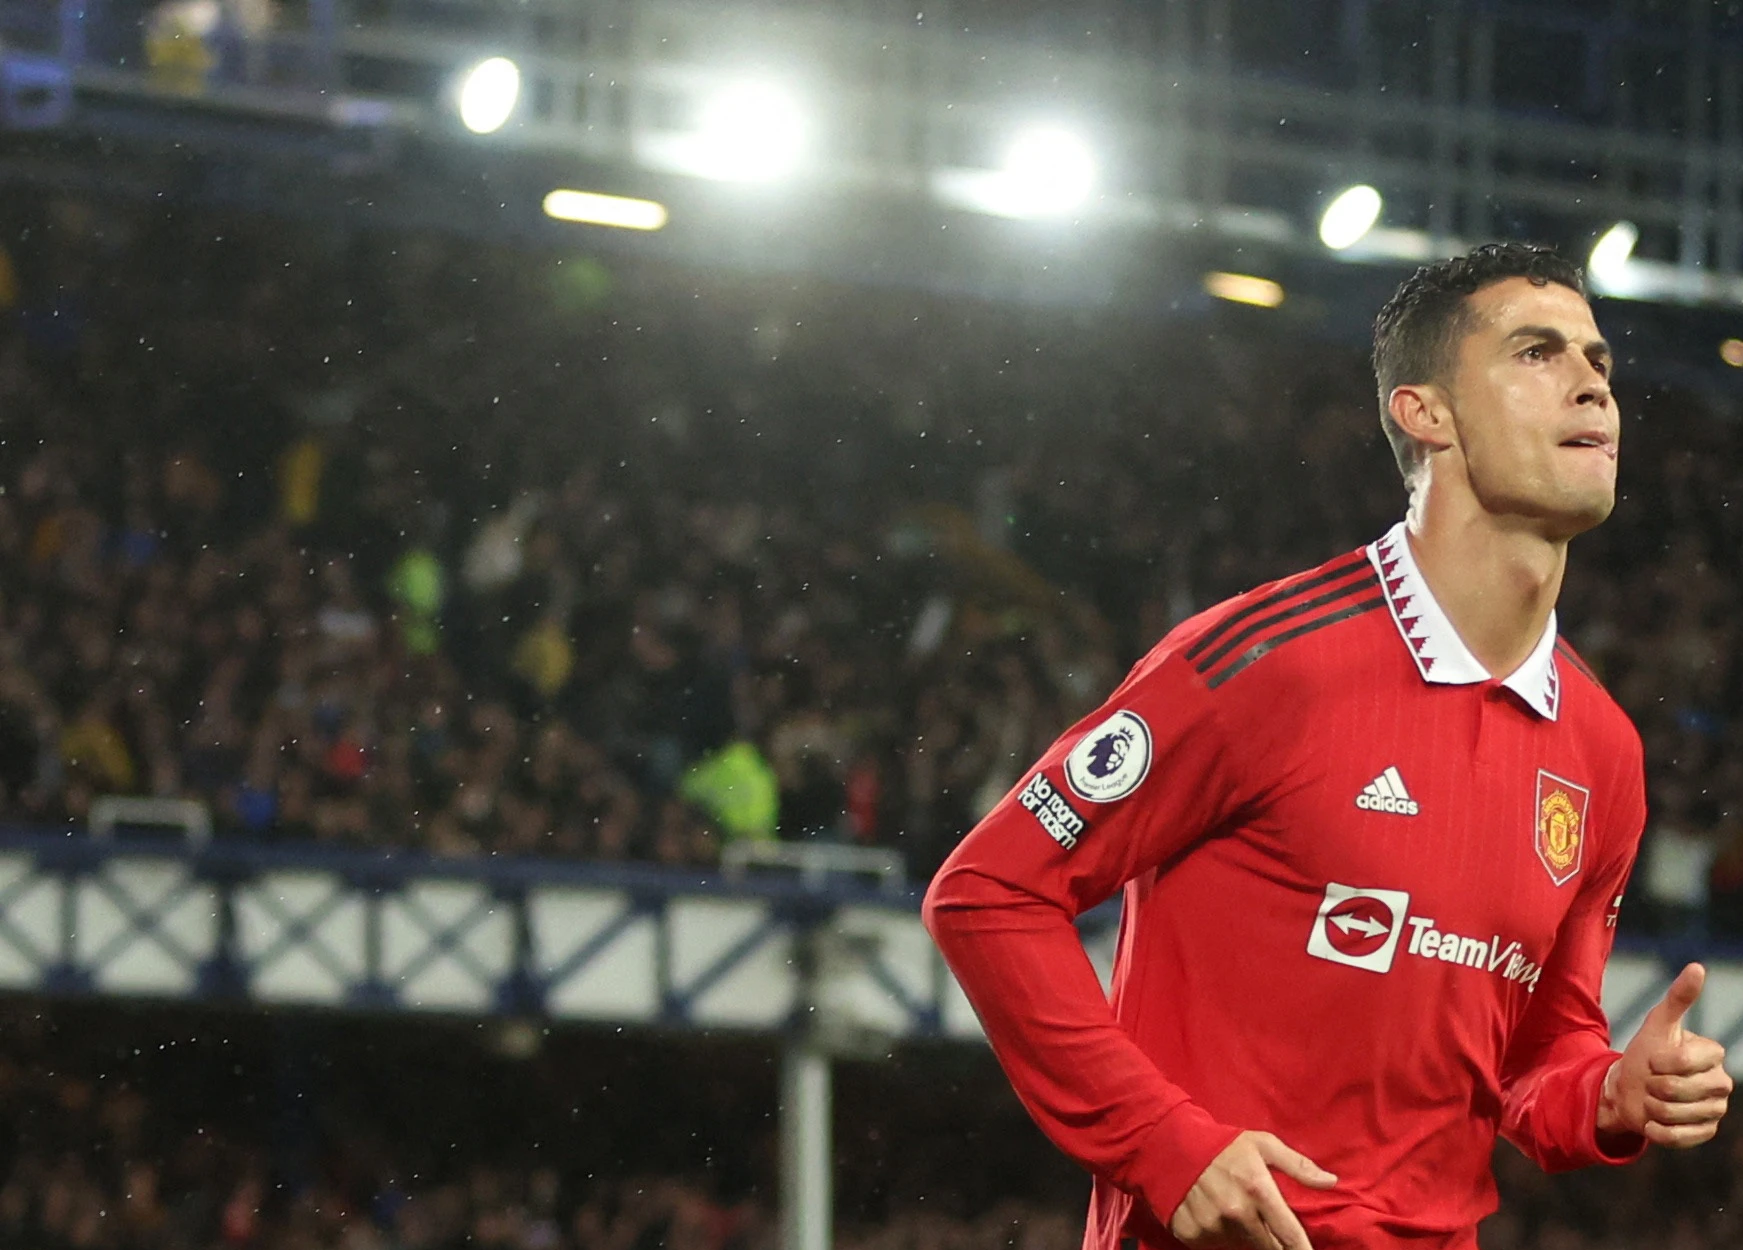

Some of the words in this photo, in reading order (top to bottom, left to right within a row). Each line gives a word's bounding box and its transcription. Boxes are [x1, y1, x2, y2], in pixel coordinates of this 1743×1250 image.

[1017, 785, 1042, 811] for
[1036, 805, 1077, 850] racism
[1028, 772, 1051, 800] No
[1047, 793, 1084, 835] room
[1356, 794, 1418, 815] adidas
[1408, 916, 1542, 993] TeamVi
